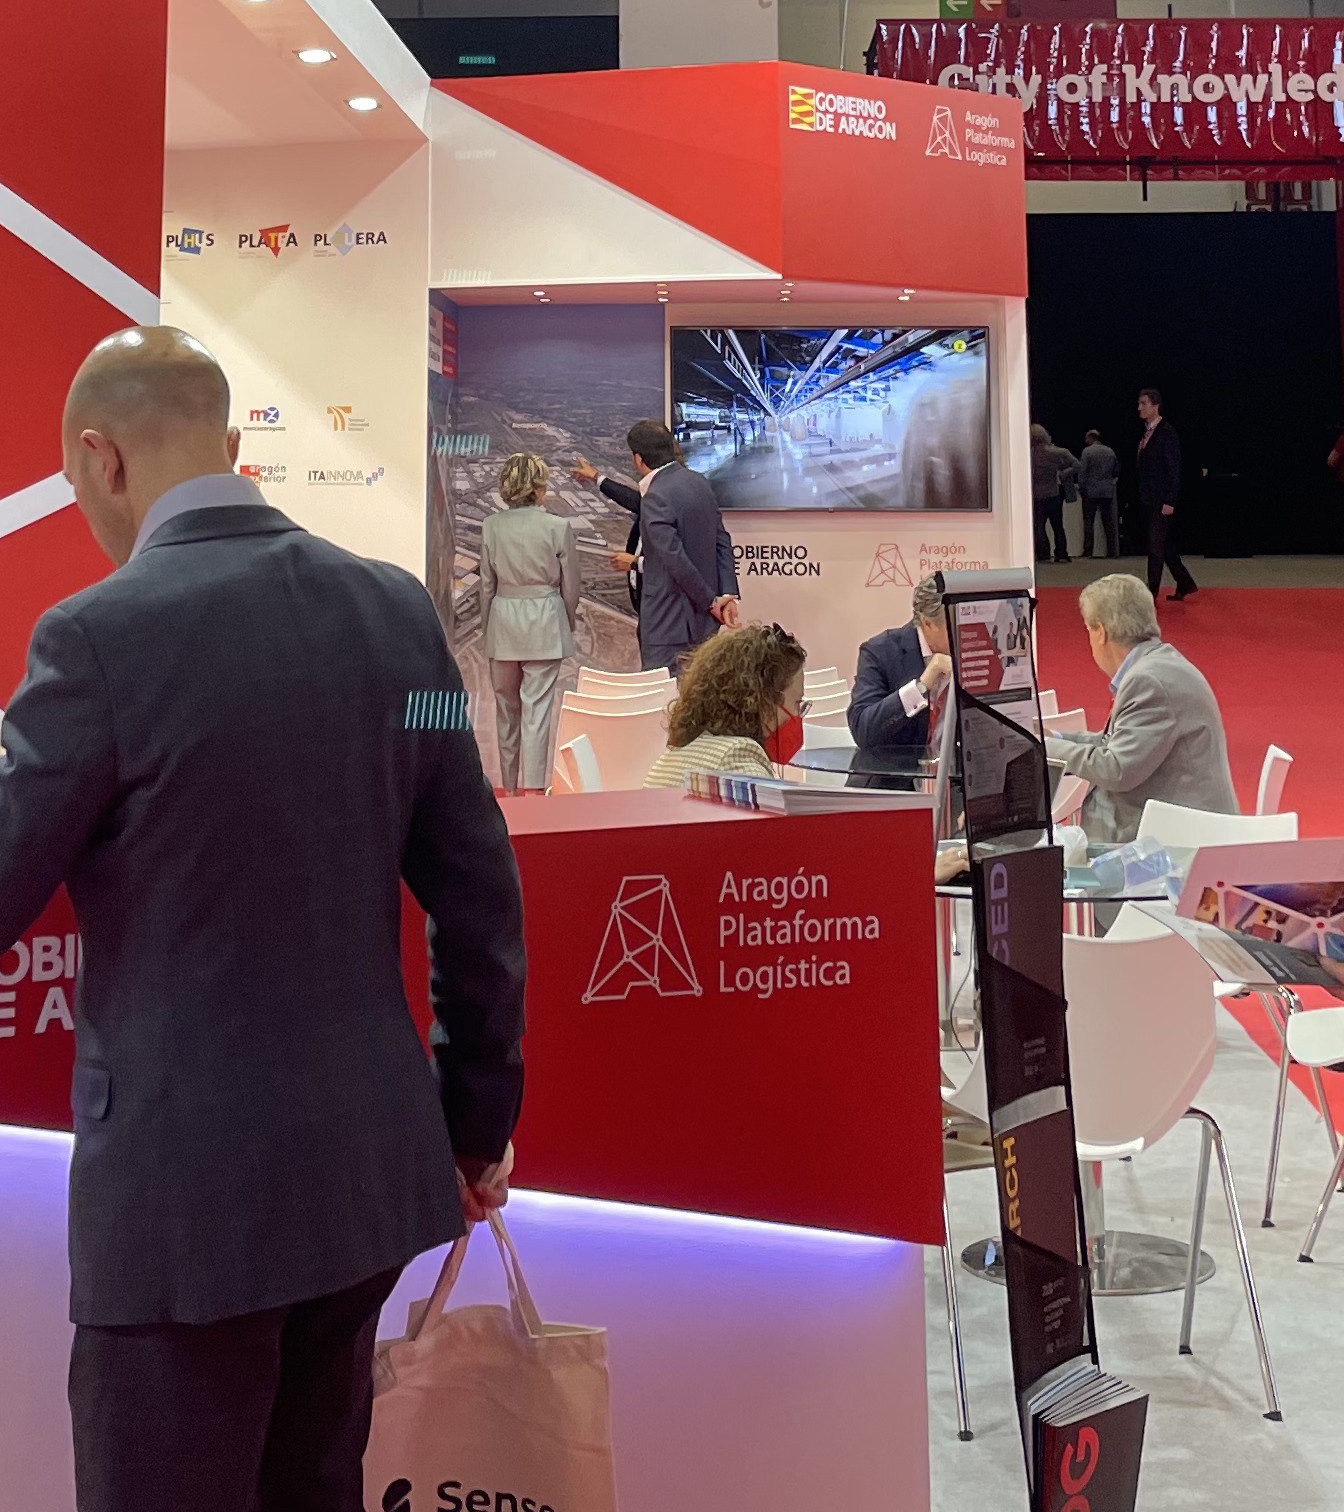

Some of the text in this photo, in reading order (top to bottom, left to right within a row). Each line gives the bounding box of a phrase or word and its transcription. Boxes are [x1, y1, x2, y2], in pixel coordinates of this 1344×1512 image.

[938, 63, 1041, 113] City
[1056, 63, 1110, 104] of
[815, 91, 887, 119] GOBIERNO
[815, 113, 897, 141] DE ARAGON
[965, 110, 1000, 130] Aragón
[965, 129, 1016, 150] Plataforma
[965, 149, 1008, 167] Logística
[732, 545, 808, 560] OBIERNO
[919, 542, 966, 558] Aragón
[735, 561, 821, 576] E ARAGON
[718, 866, 828, 909] Aragón
[719, 909, 880, 948] Plataforma
[719, 954, 851, 999] Logística
